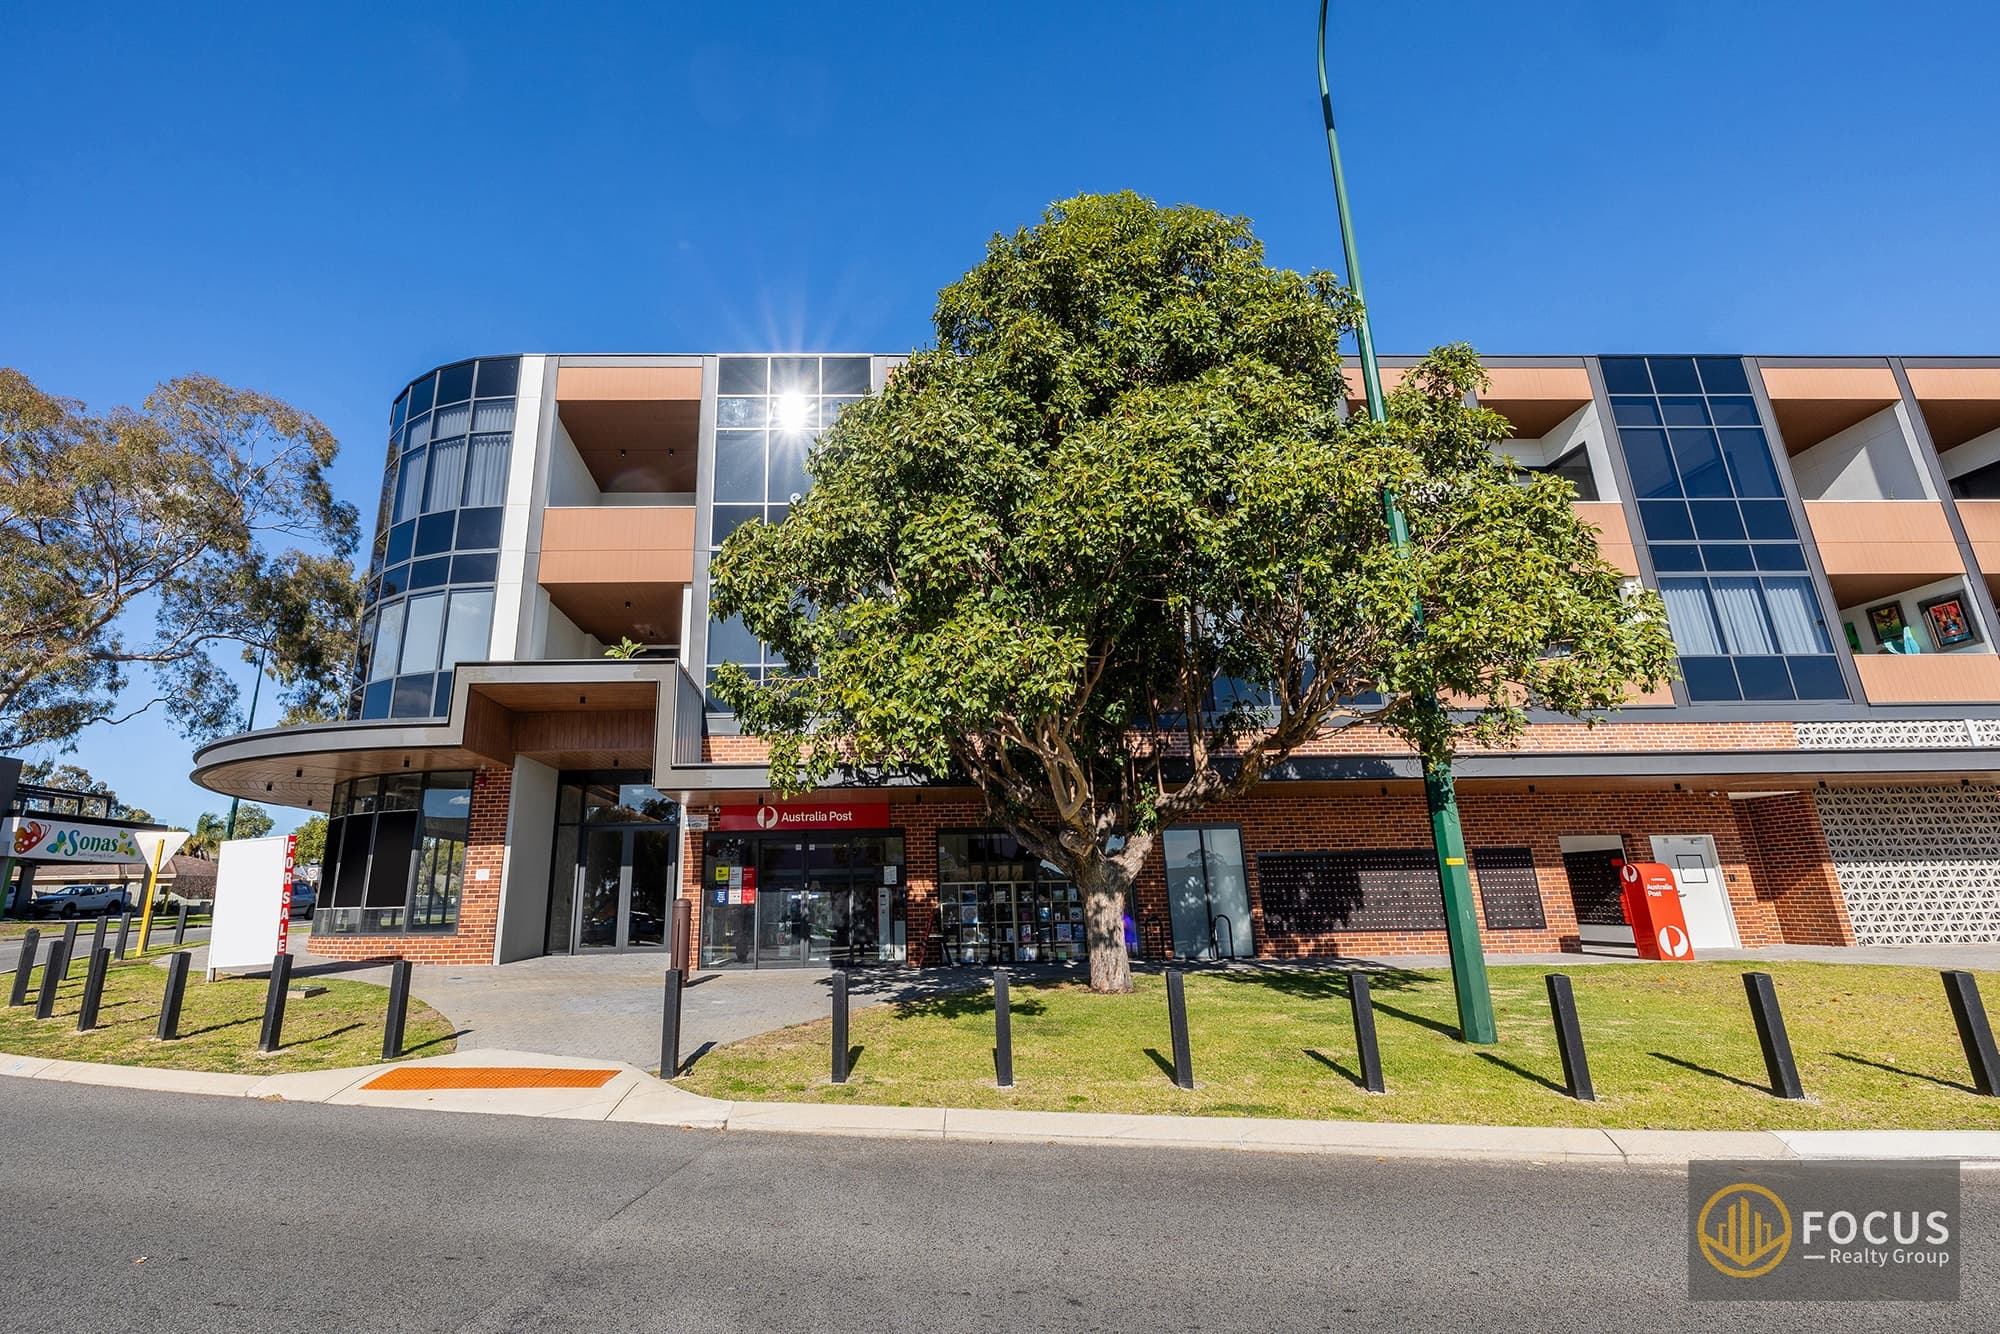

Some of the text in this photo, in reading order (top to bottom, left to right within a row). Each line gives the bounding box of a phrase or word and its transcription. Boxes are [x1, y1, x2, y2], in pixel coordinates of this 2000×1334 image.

[781, 811, 853, 822] Australia Post
[64, 829, 119, 856] Sonas
[278, 841, 296, 952] FOR SALE
[1646, 883, 1673, 891] Australia
